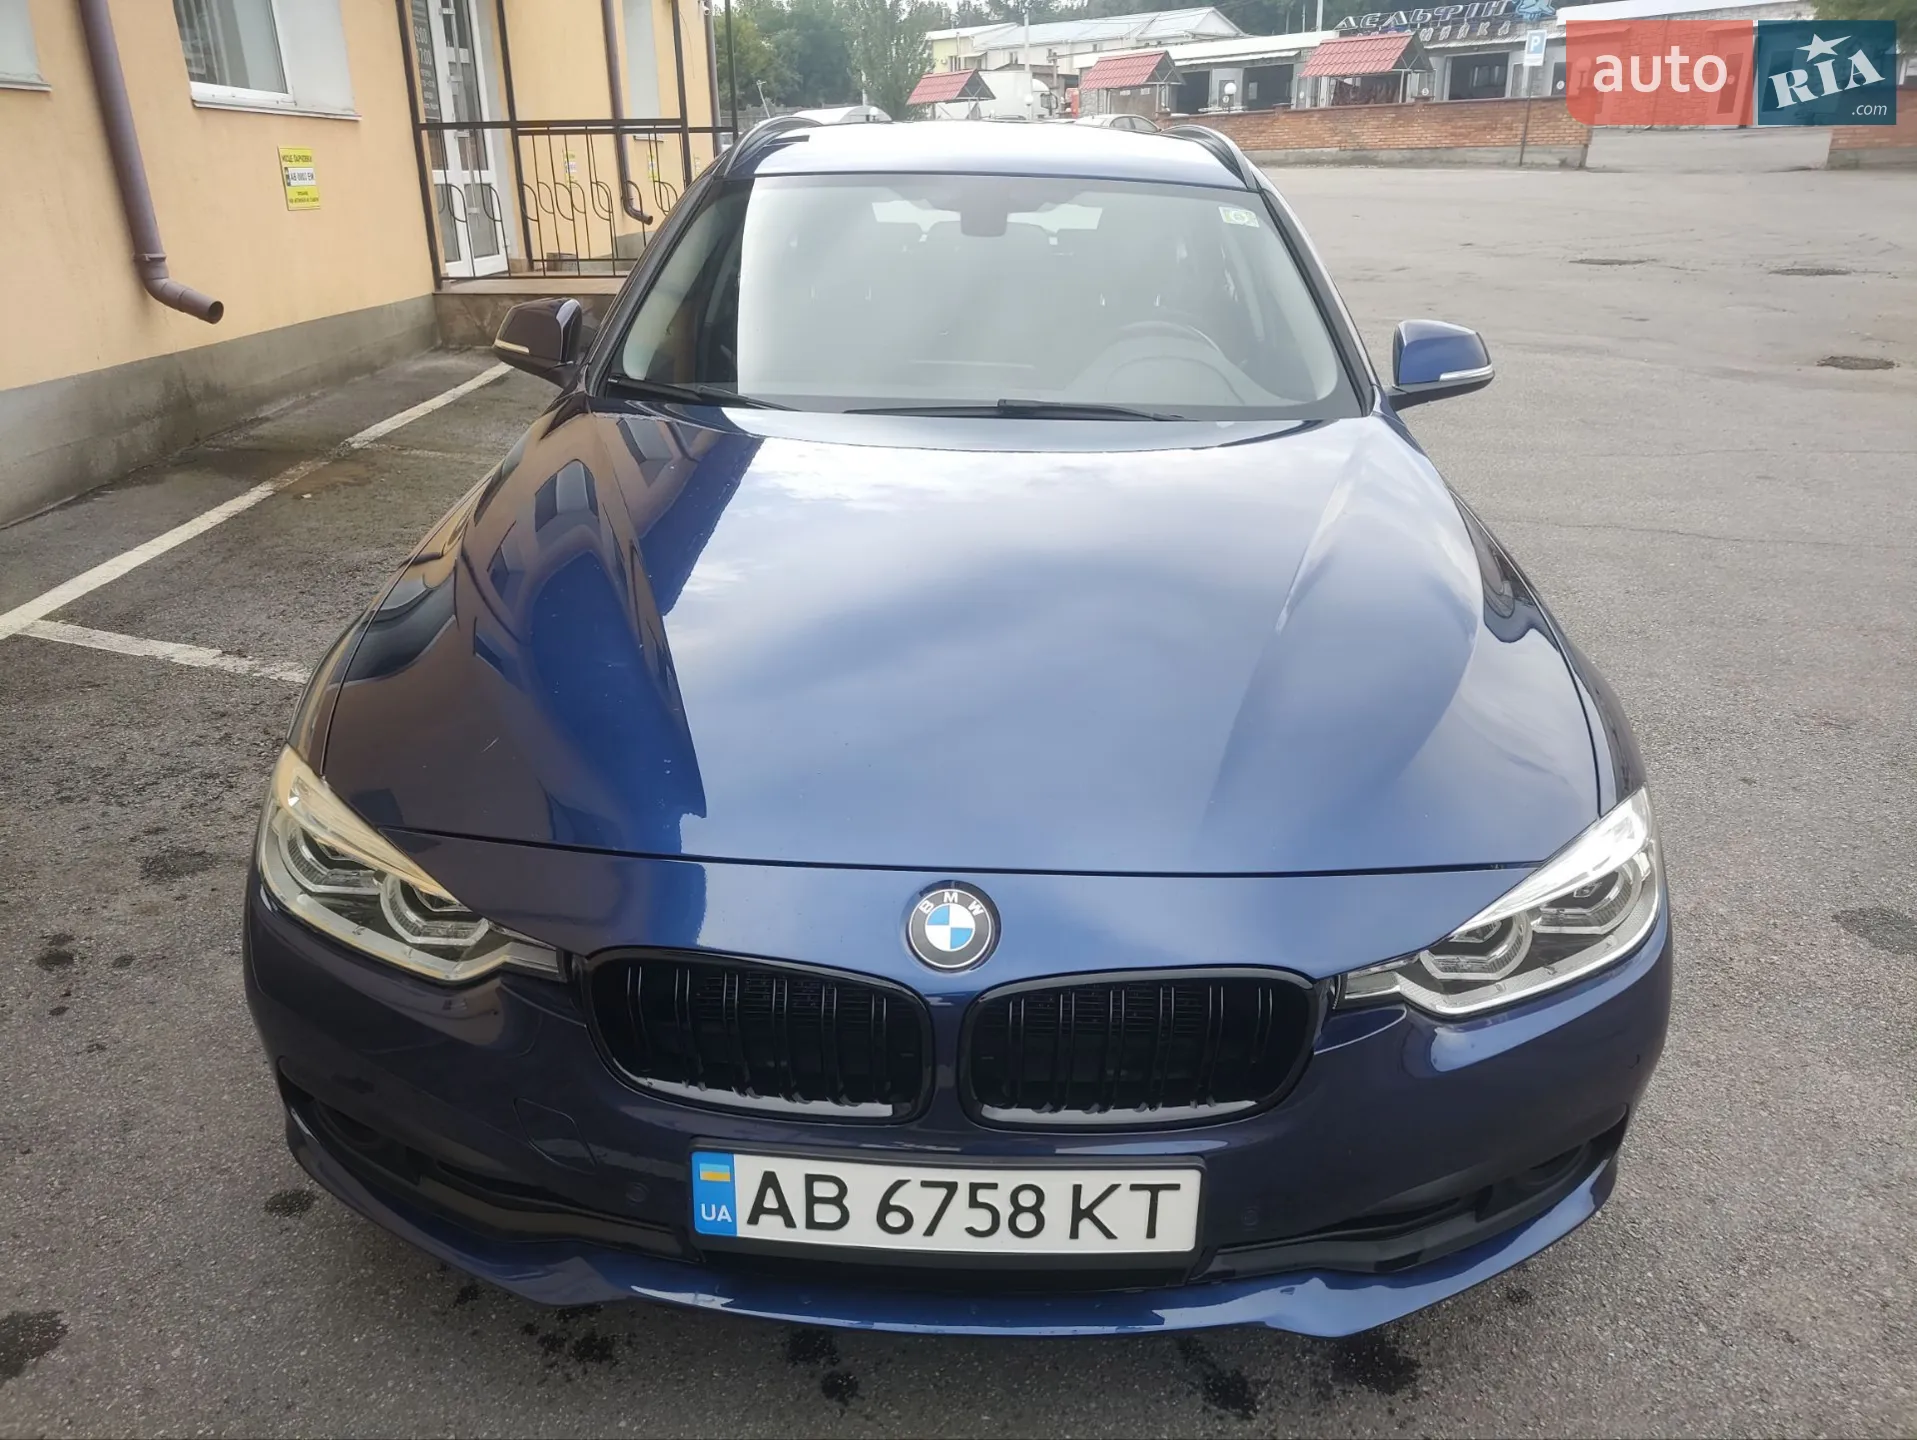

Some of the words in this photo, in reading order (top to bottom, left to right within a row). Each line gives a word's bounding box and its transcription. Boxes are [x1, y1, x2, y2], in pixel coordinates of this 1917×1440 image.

[919, 891, 984, 917] BMW
[701, 1203, 732, 1223] UA
[747, 1170, 850, 1231] AB
[876, 1179, 1046, 1238] 6758
[1069, 1183, 1181, 1240] KT
